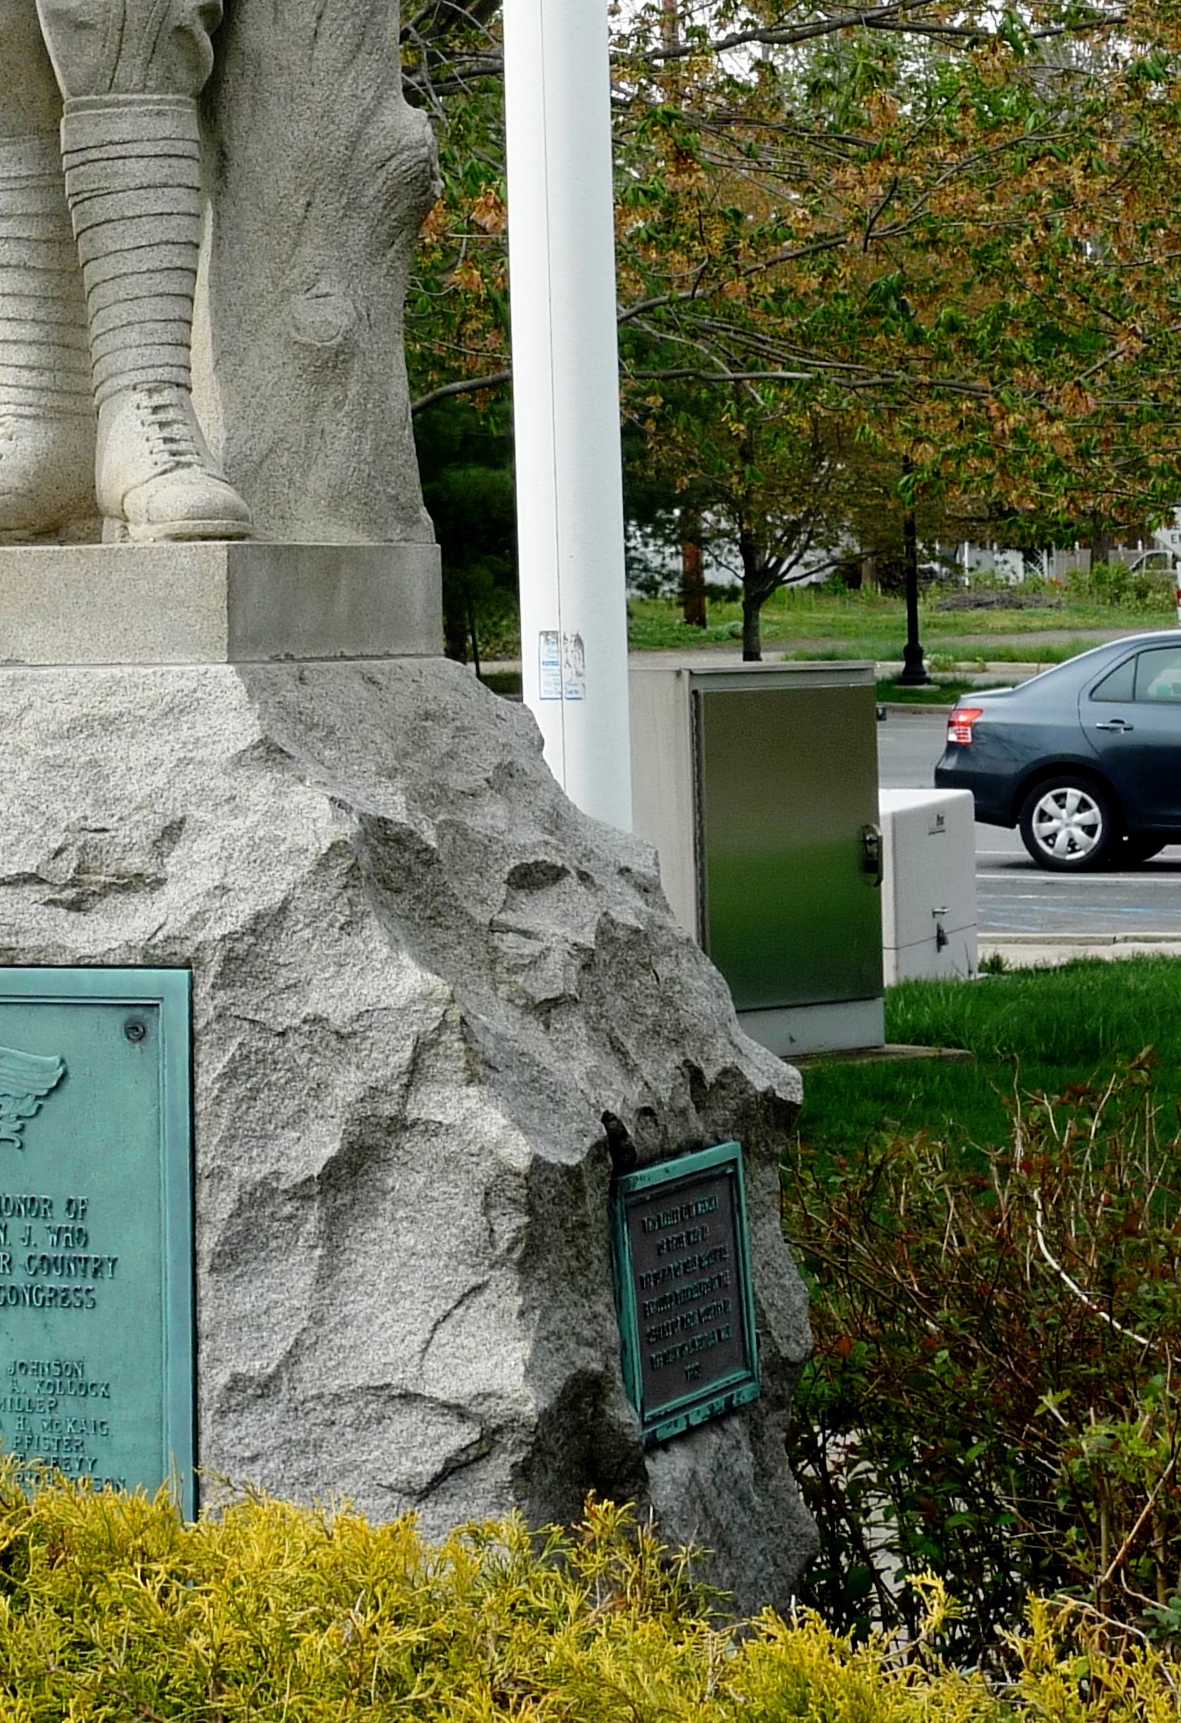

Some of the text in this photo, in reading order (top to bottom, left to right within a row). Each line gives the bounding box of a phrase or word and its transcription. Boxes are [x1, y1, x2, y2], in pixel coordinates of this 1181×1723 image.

[65, 1195, 89, 1220] OF
[20, 1225, 38, 1247] J.
[46, 1225, 89, 1249] WHO
[25, 1252, 118, 1280] COUNTRY
[6, 1359, 85, 1378] JOHNSON
[34, 1379, 111, 1399] KOLLOCK
[12, 1435, 86, 1454] PFISTER
